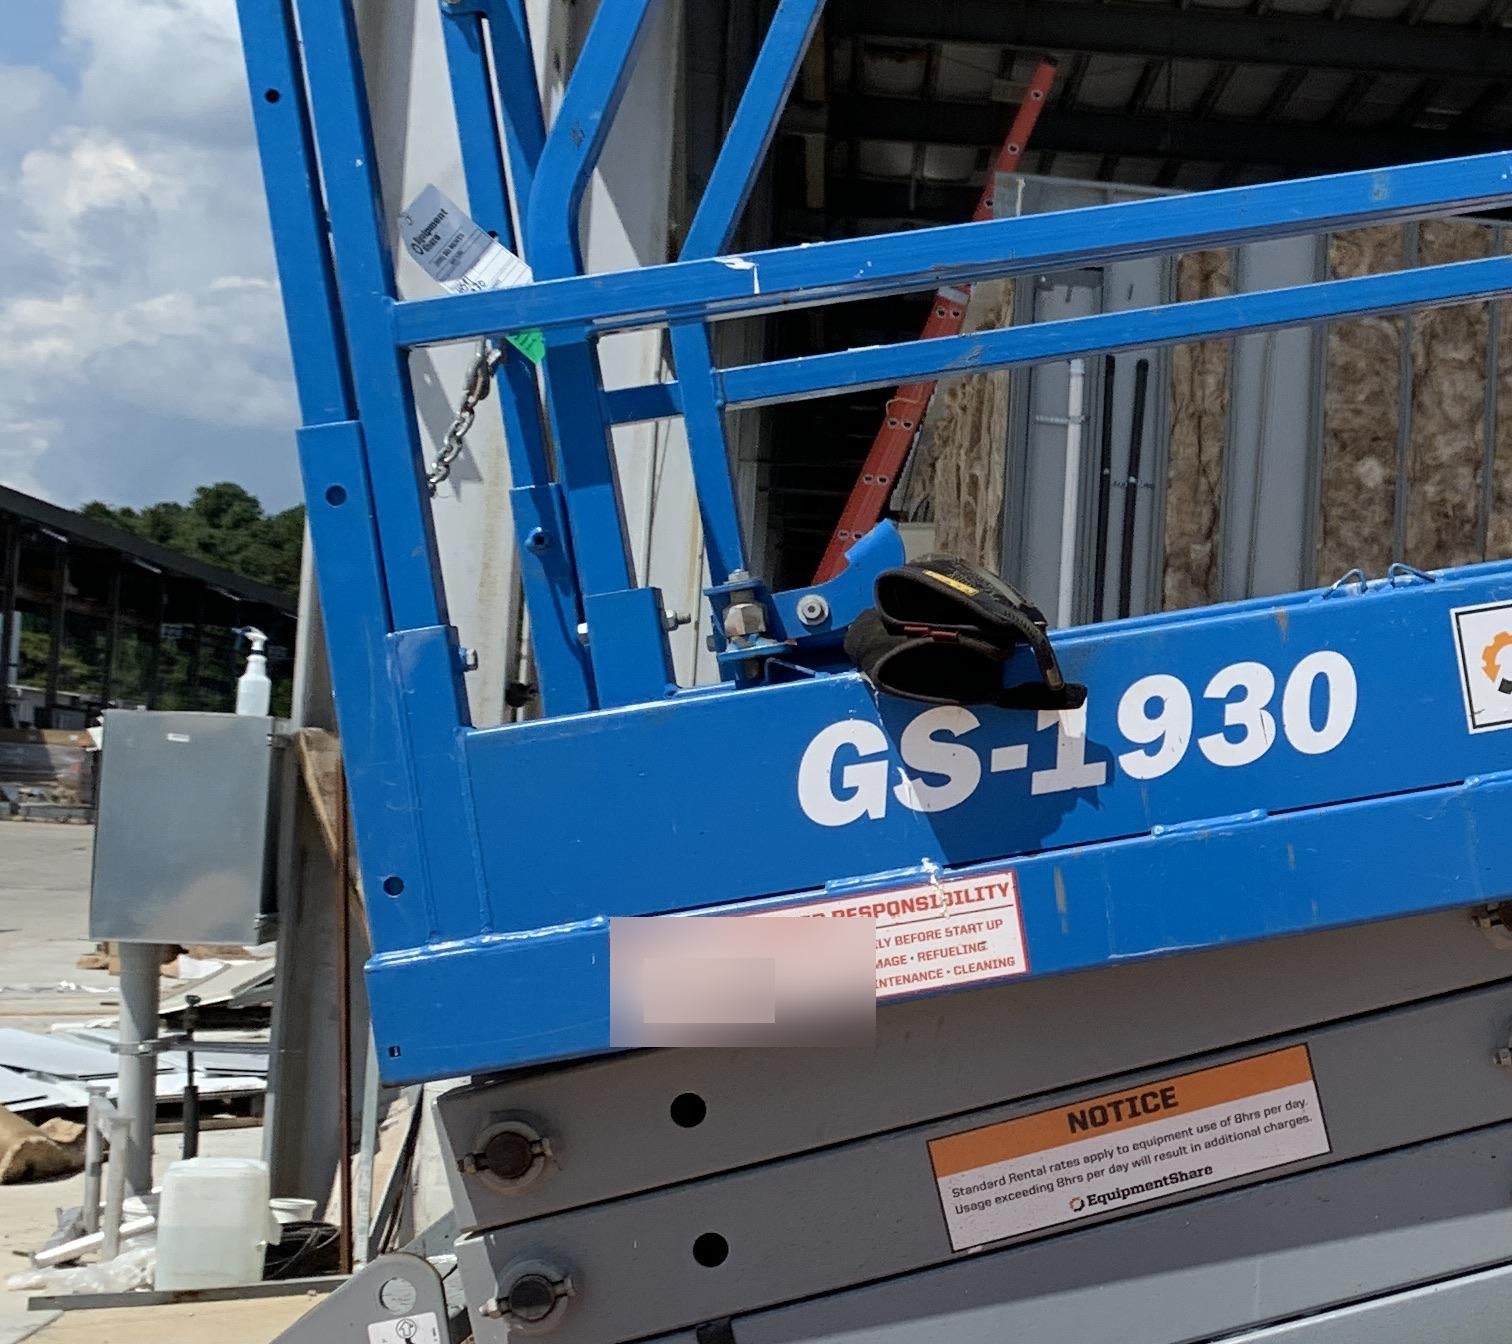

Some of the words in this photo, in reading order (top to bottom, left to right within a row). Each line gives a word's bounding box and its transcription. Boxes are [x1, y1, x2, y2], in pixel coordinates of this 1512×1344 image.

[799, 651, 1358, 827] GS-1930
[893, 928, 942, 946] BEFORE
[943, 920, 984, 938] START
[985, 917, 1004, 931] UP
[916, 940, 985, 962] REFUELING
[952, 955, 1016, 976] CLEANING
[1066, 1085, 1180, 1134] NOTICE
[950, 1175, 1007, 1198] Standard
[1007, 1164, 1047, 1184] Rental
[1048, 1157, 1081, 1173] rates
[1081, 1147, 1115, 1166] apply
[1116, 1143, 1130, 1155] to
[1131, 1126, 1194, 1153] equipment
[1195, 1121, 1217, 1134] use
[1218, 1115, 1233, 1128] of
[1233, 1108, 1261, 1125] 8hrs
[1262, 1104, 1284, 1119] per
[954, 1197, 992, 1216] Usage
[993, 1179, 1055, 1206] exceeding
[1055, 1172, 1084, 1188] 8hrs
[1085, 1167, 1106, 1182] per
[1106, 1160, 1131, 1177] day
[1130, 1154, 1152, 1168] will
[1152, 1145, 1188, 1163] result
[1189, 1141, 1202, 1153] in
[1202, 1125, 1262, 1150] additional
[1262, 1112, 1313, 1135] charges.
[1085, 1163, 1215, 1208] EquipmentShare
